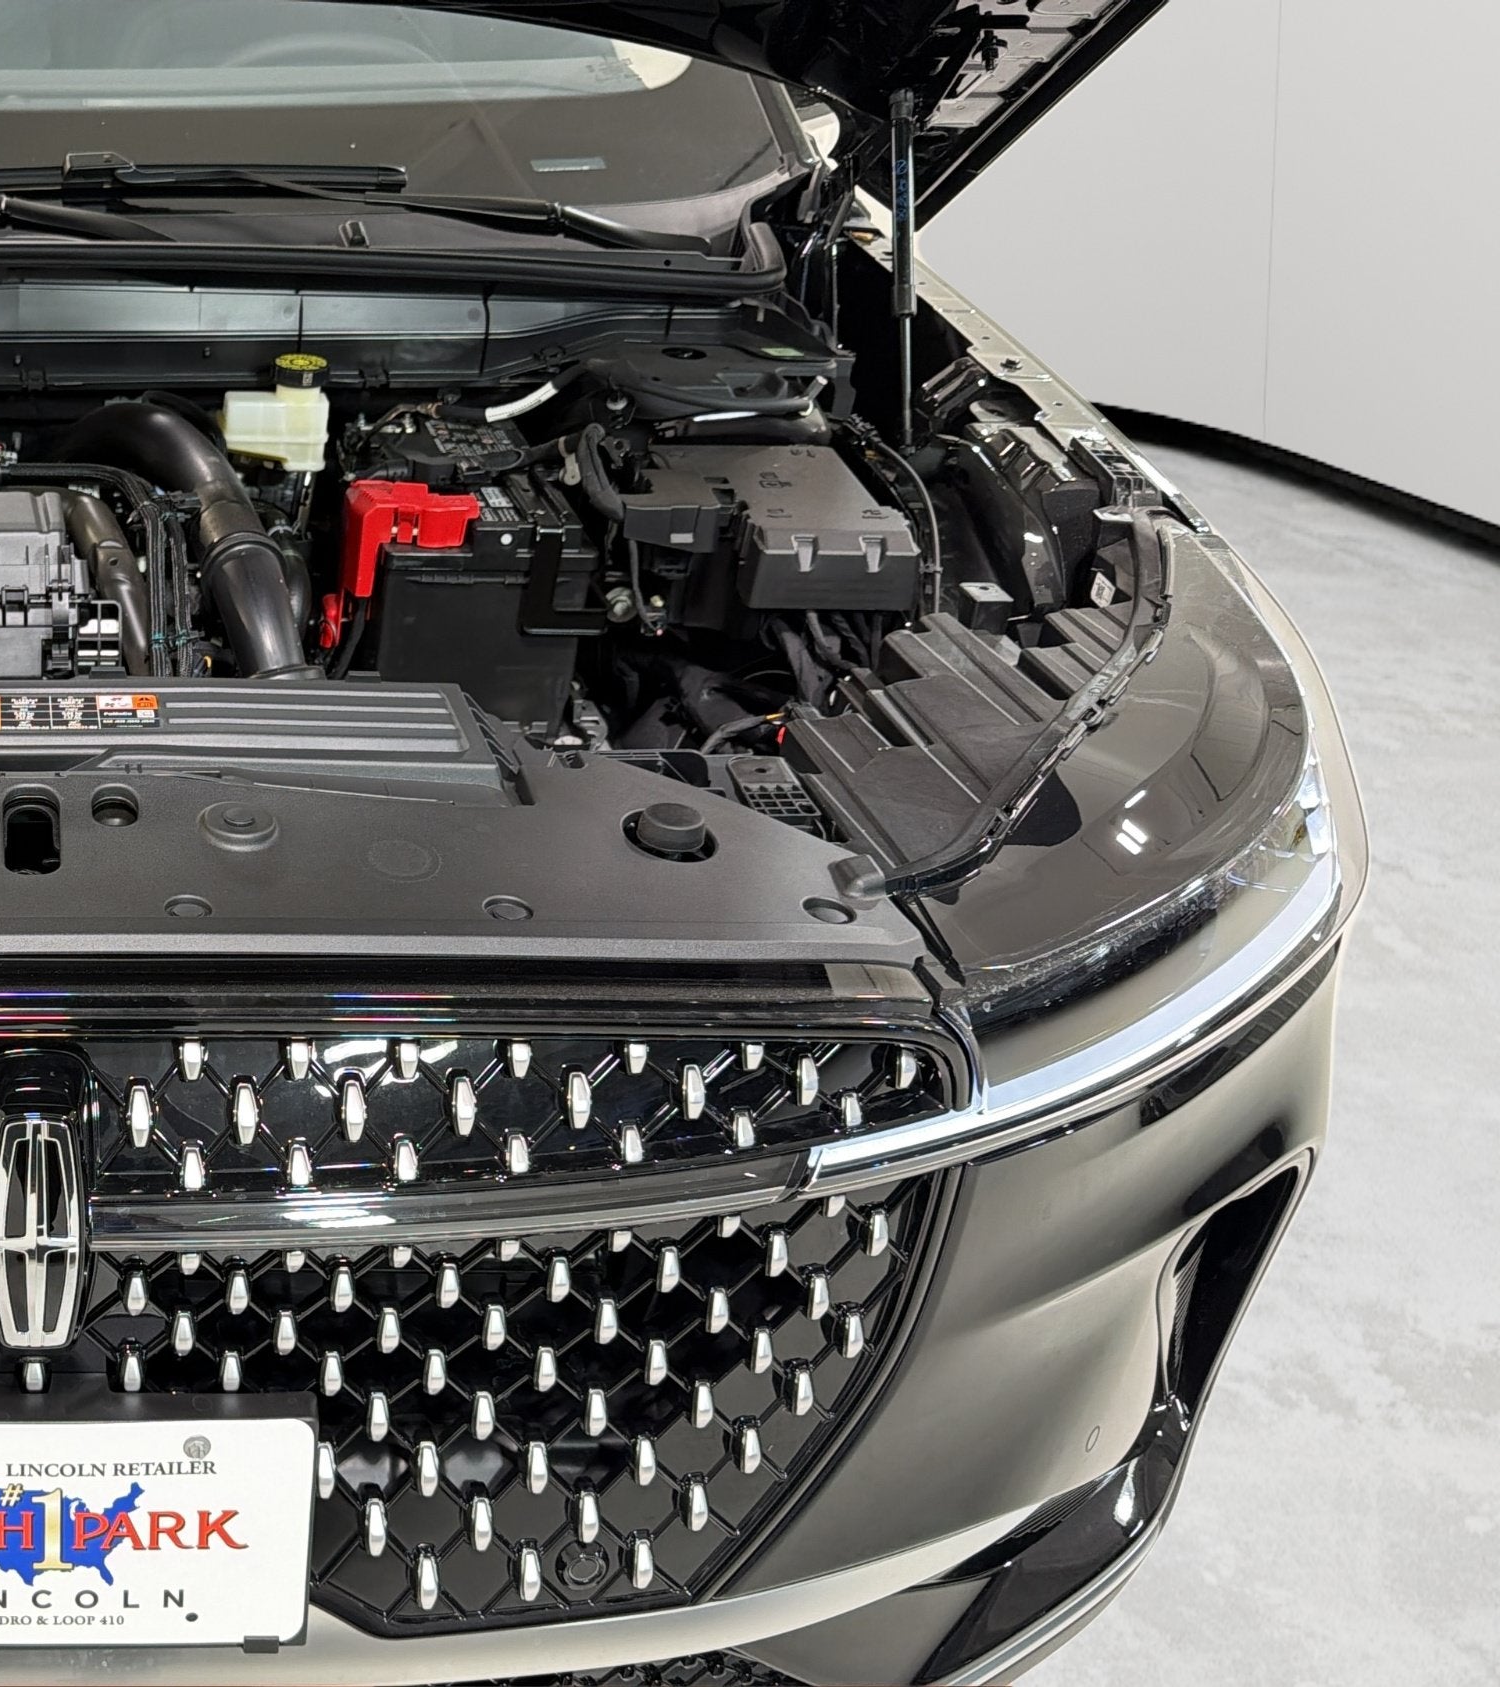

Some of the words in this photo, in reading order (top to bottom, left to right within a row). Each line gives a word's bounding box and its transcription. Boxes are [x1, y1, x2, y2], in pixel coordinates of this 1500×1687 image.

[6, 1463, 106, 1478] LINCOLN
[113, 1460, 217, 1477] RETAILER
[72, 1509, 249, 1551] PARK
[36, 1614, 49, 1626] &
[53, 1614, 96, 1626] LOOP
[99, 1614, 125, 1626] 410
